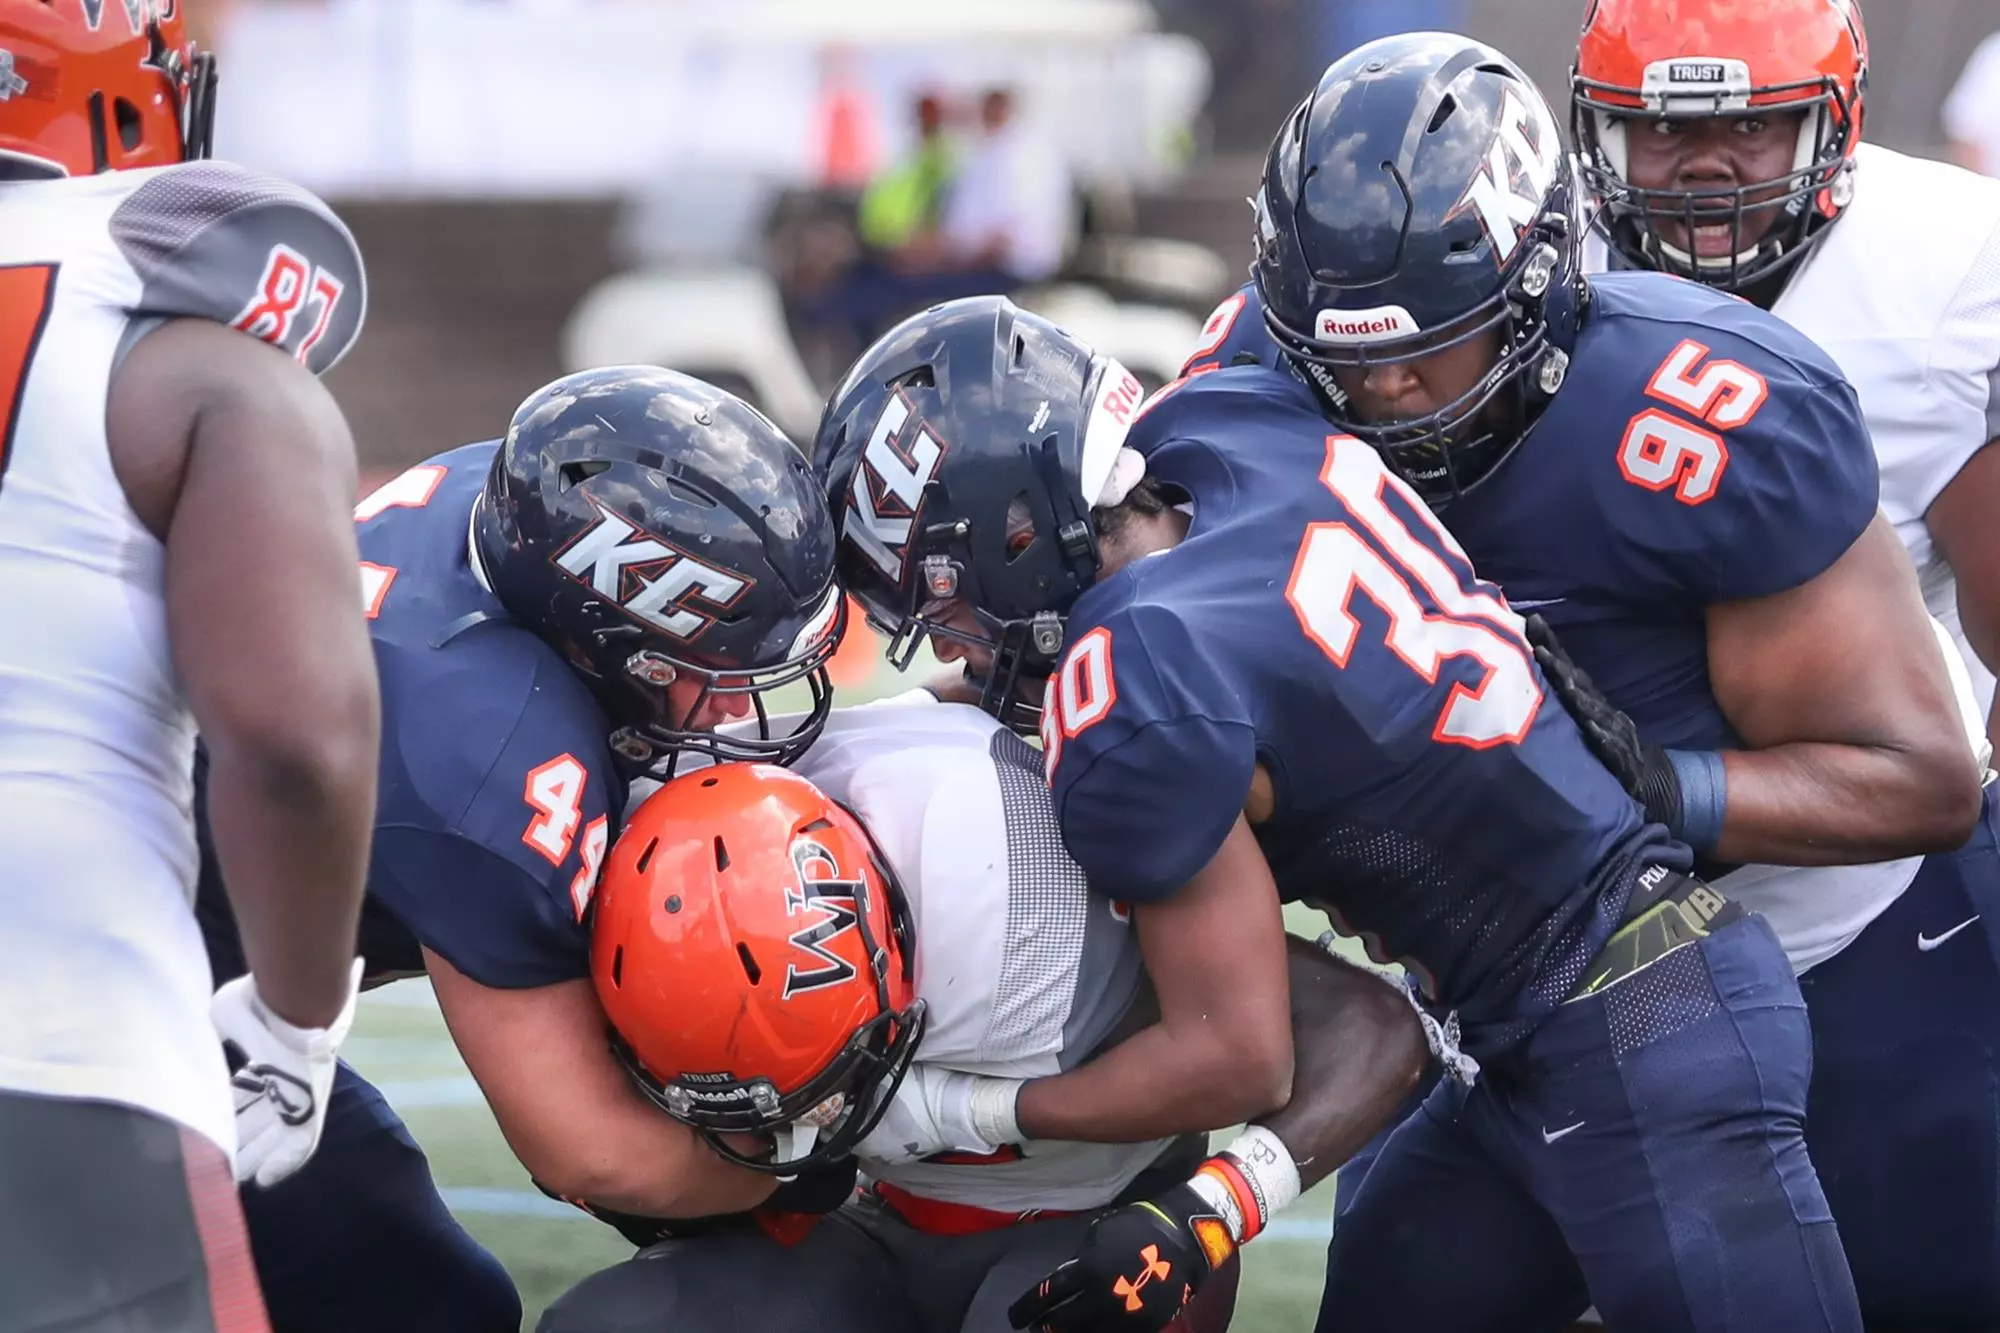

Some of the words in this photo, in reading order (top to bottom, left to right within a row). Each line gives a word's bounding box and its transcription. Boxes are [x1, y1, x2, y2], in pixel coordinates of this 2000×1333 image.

[1671, 65, 1723, 81] TRUST
[1441, 82, 1560, 272] KC
[229, 243, 345, 366] 87
[1323, 316, 1400, 336] Riddell
[838, 383, 950, 592] KC
[1616, 338, 1769, 506] 95
[549, 487, 758, 645] KC
[1285, 433, 1545, 750] 30
[782, 838, 872, 1001] WP
[680, 1071, 730, 1084] TRUST
